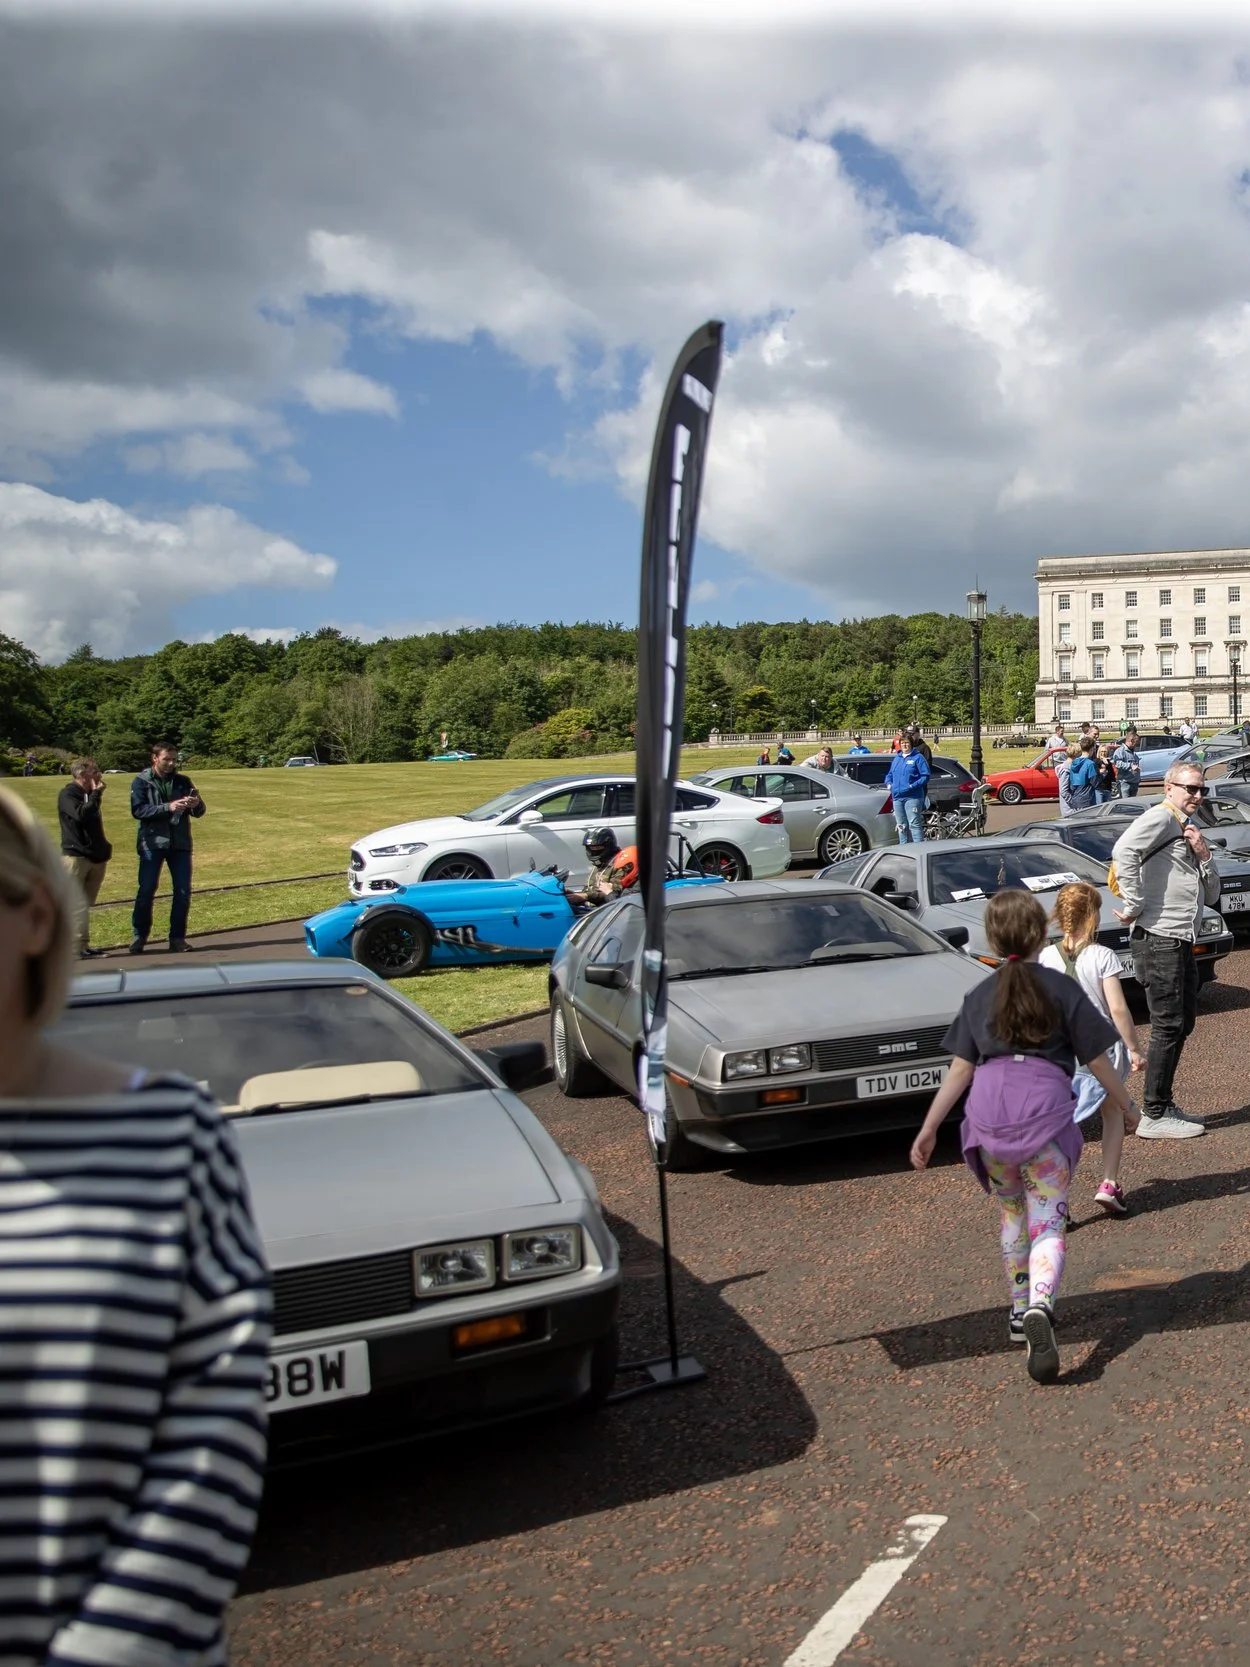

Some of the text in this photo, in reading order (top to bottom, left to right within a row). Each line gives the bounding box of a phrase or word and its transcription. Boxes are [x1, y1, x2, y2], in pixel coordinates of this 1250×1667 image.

[1229, 894, 1243, 903] MKU
[1228, 902, 1246, 910] 478W
[865, 1069, 942, 1093] TDV 102W
